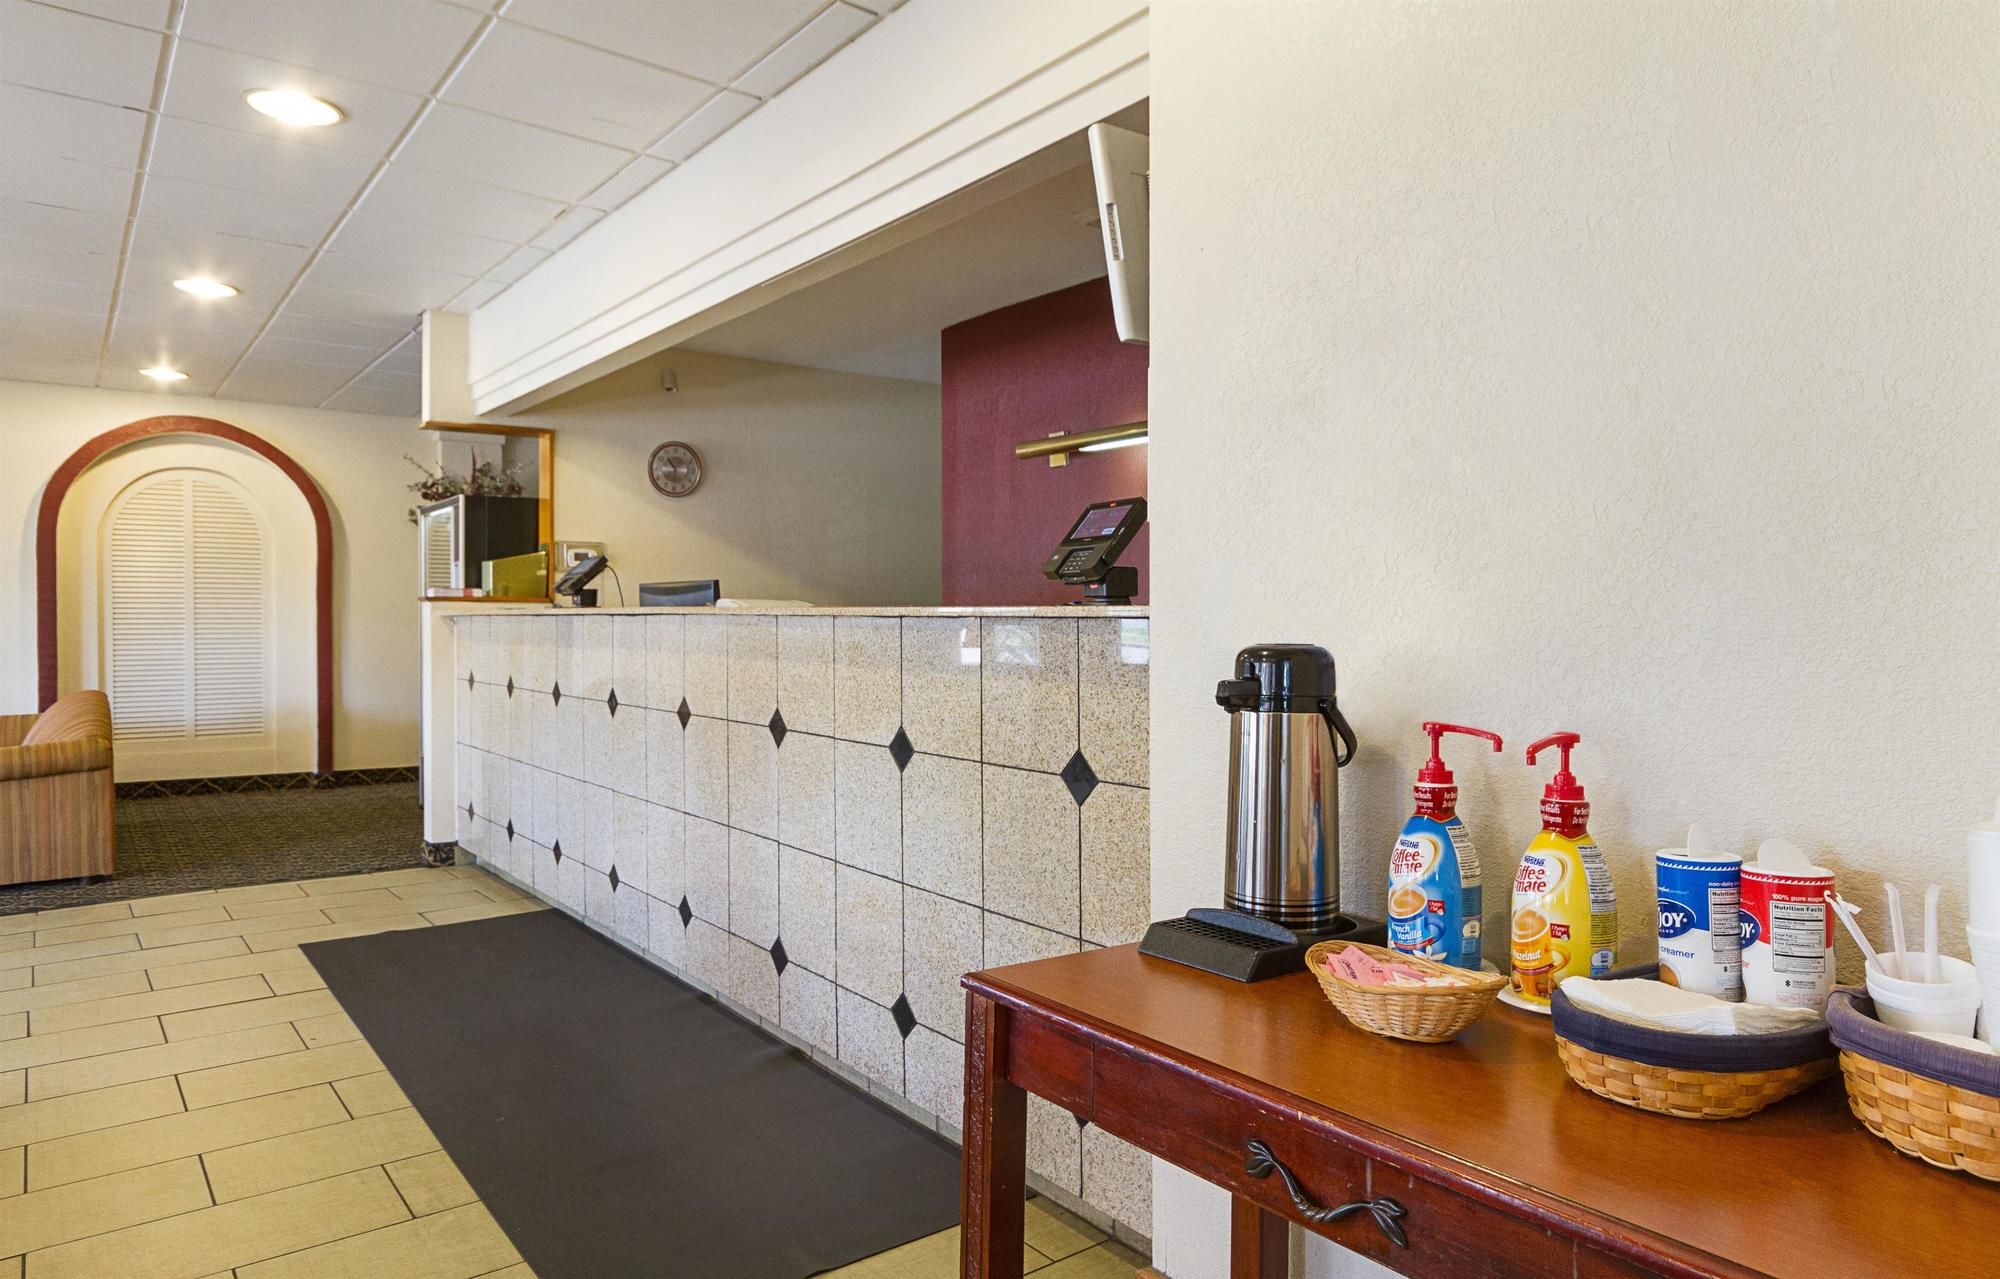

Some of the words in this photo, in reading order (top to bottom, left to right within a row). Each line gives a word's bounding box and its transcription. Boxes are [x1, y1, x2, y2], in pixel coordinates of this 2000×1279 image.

[1772, 893, 1790, 901] 100%
[1774, 904, 1805, 912] Nutrition
[1391, 922, 1411, 934] French
[1397, 929, 1424, 941] Vanilla
[1660, 945, 1696, 959] creamer
